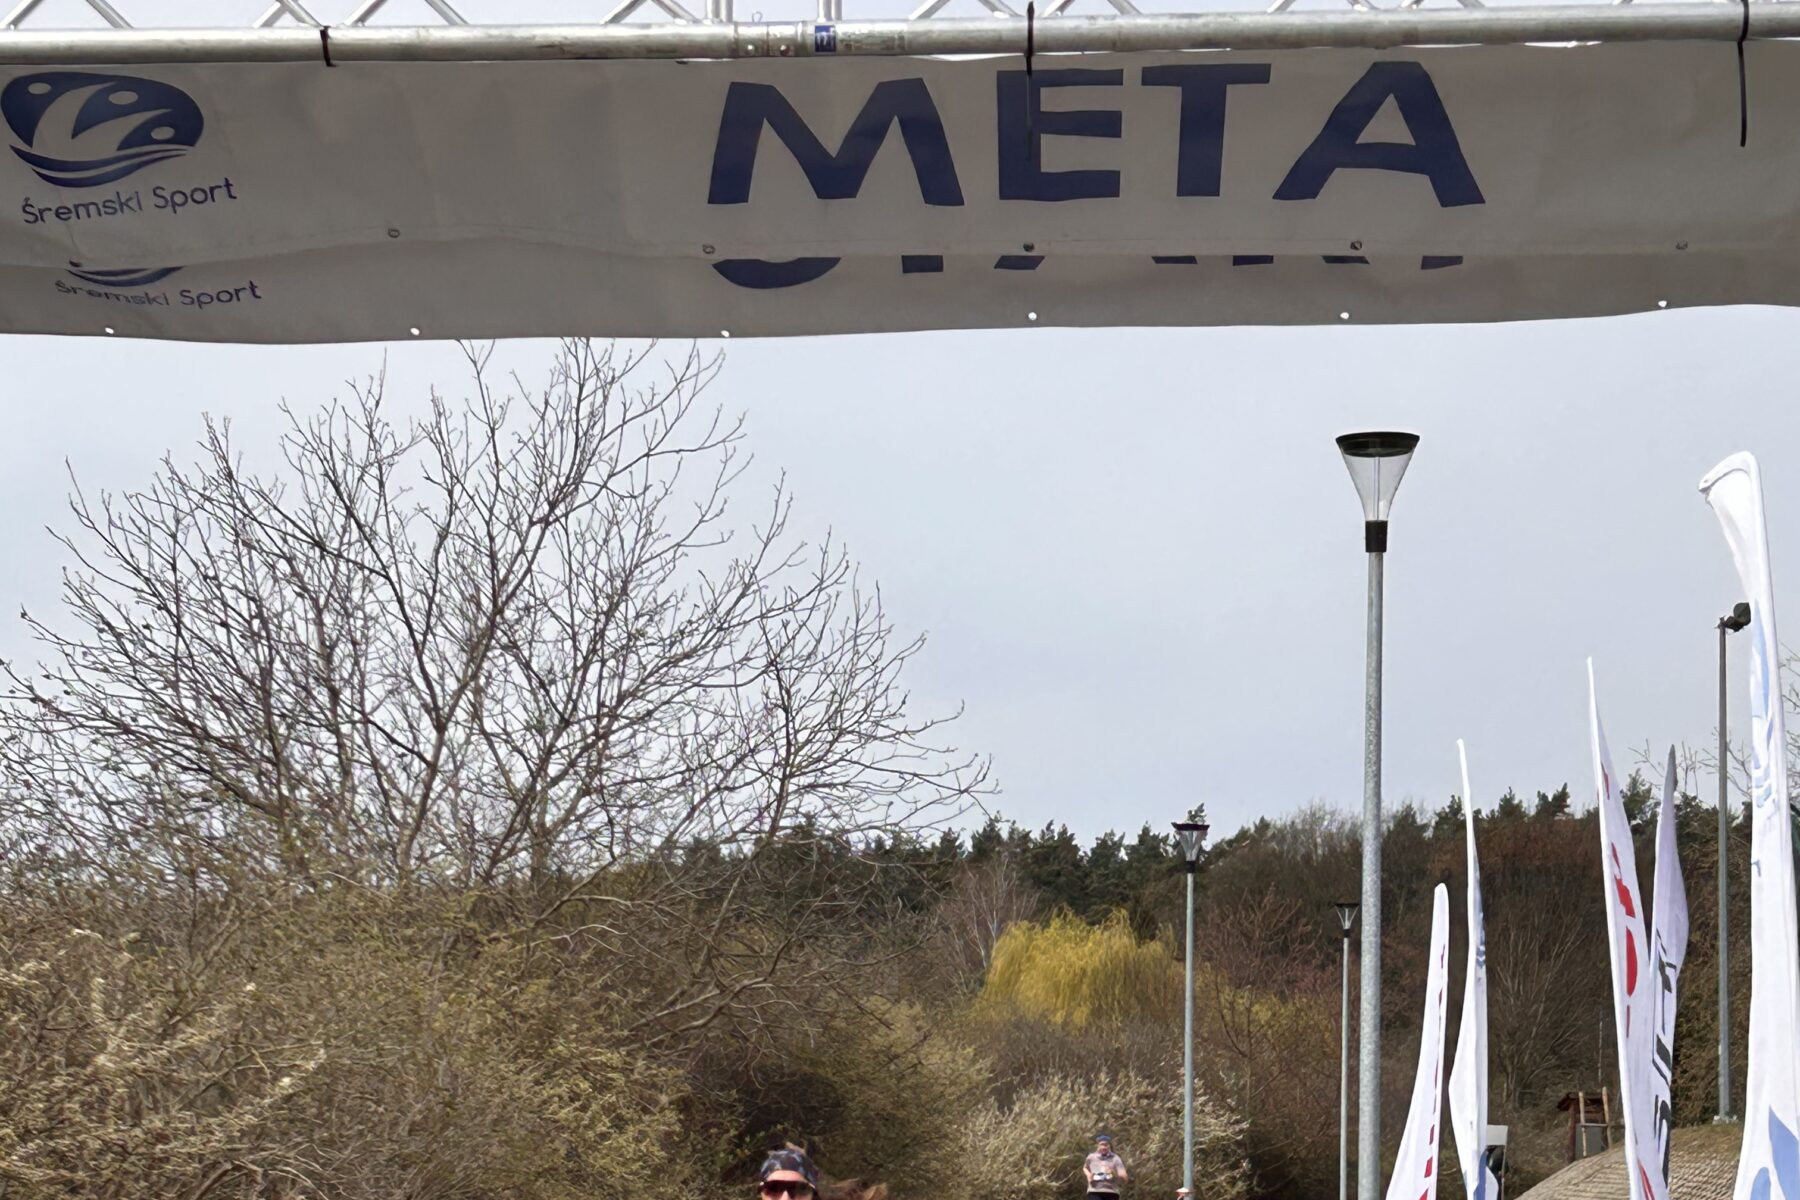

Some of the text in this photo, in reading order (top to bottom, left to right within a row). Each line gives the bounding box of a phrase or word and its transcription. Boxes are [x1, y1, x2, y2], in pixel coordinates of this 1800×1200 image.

[708, 60, 1486, 208] META
[22, 177, 237, 224] Śremski Sport
[179, 280, 262, 309] Sport
